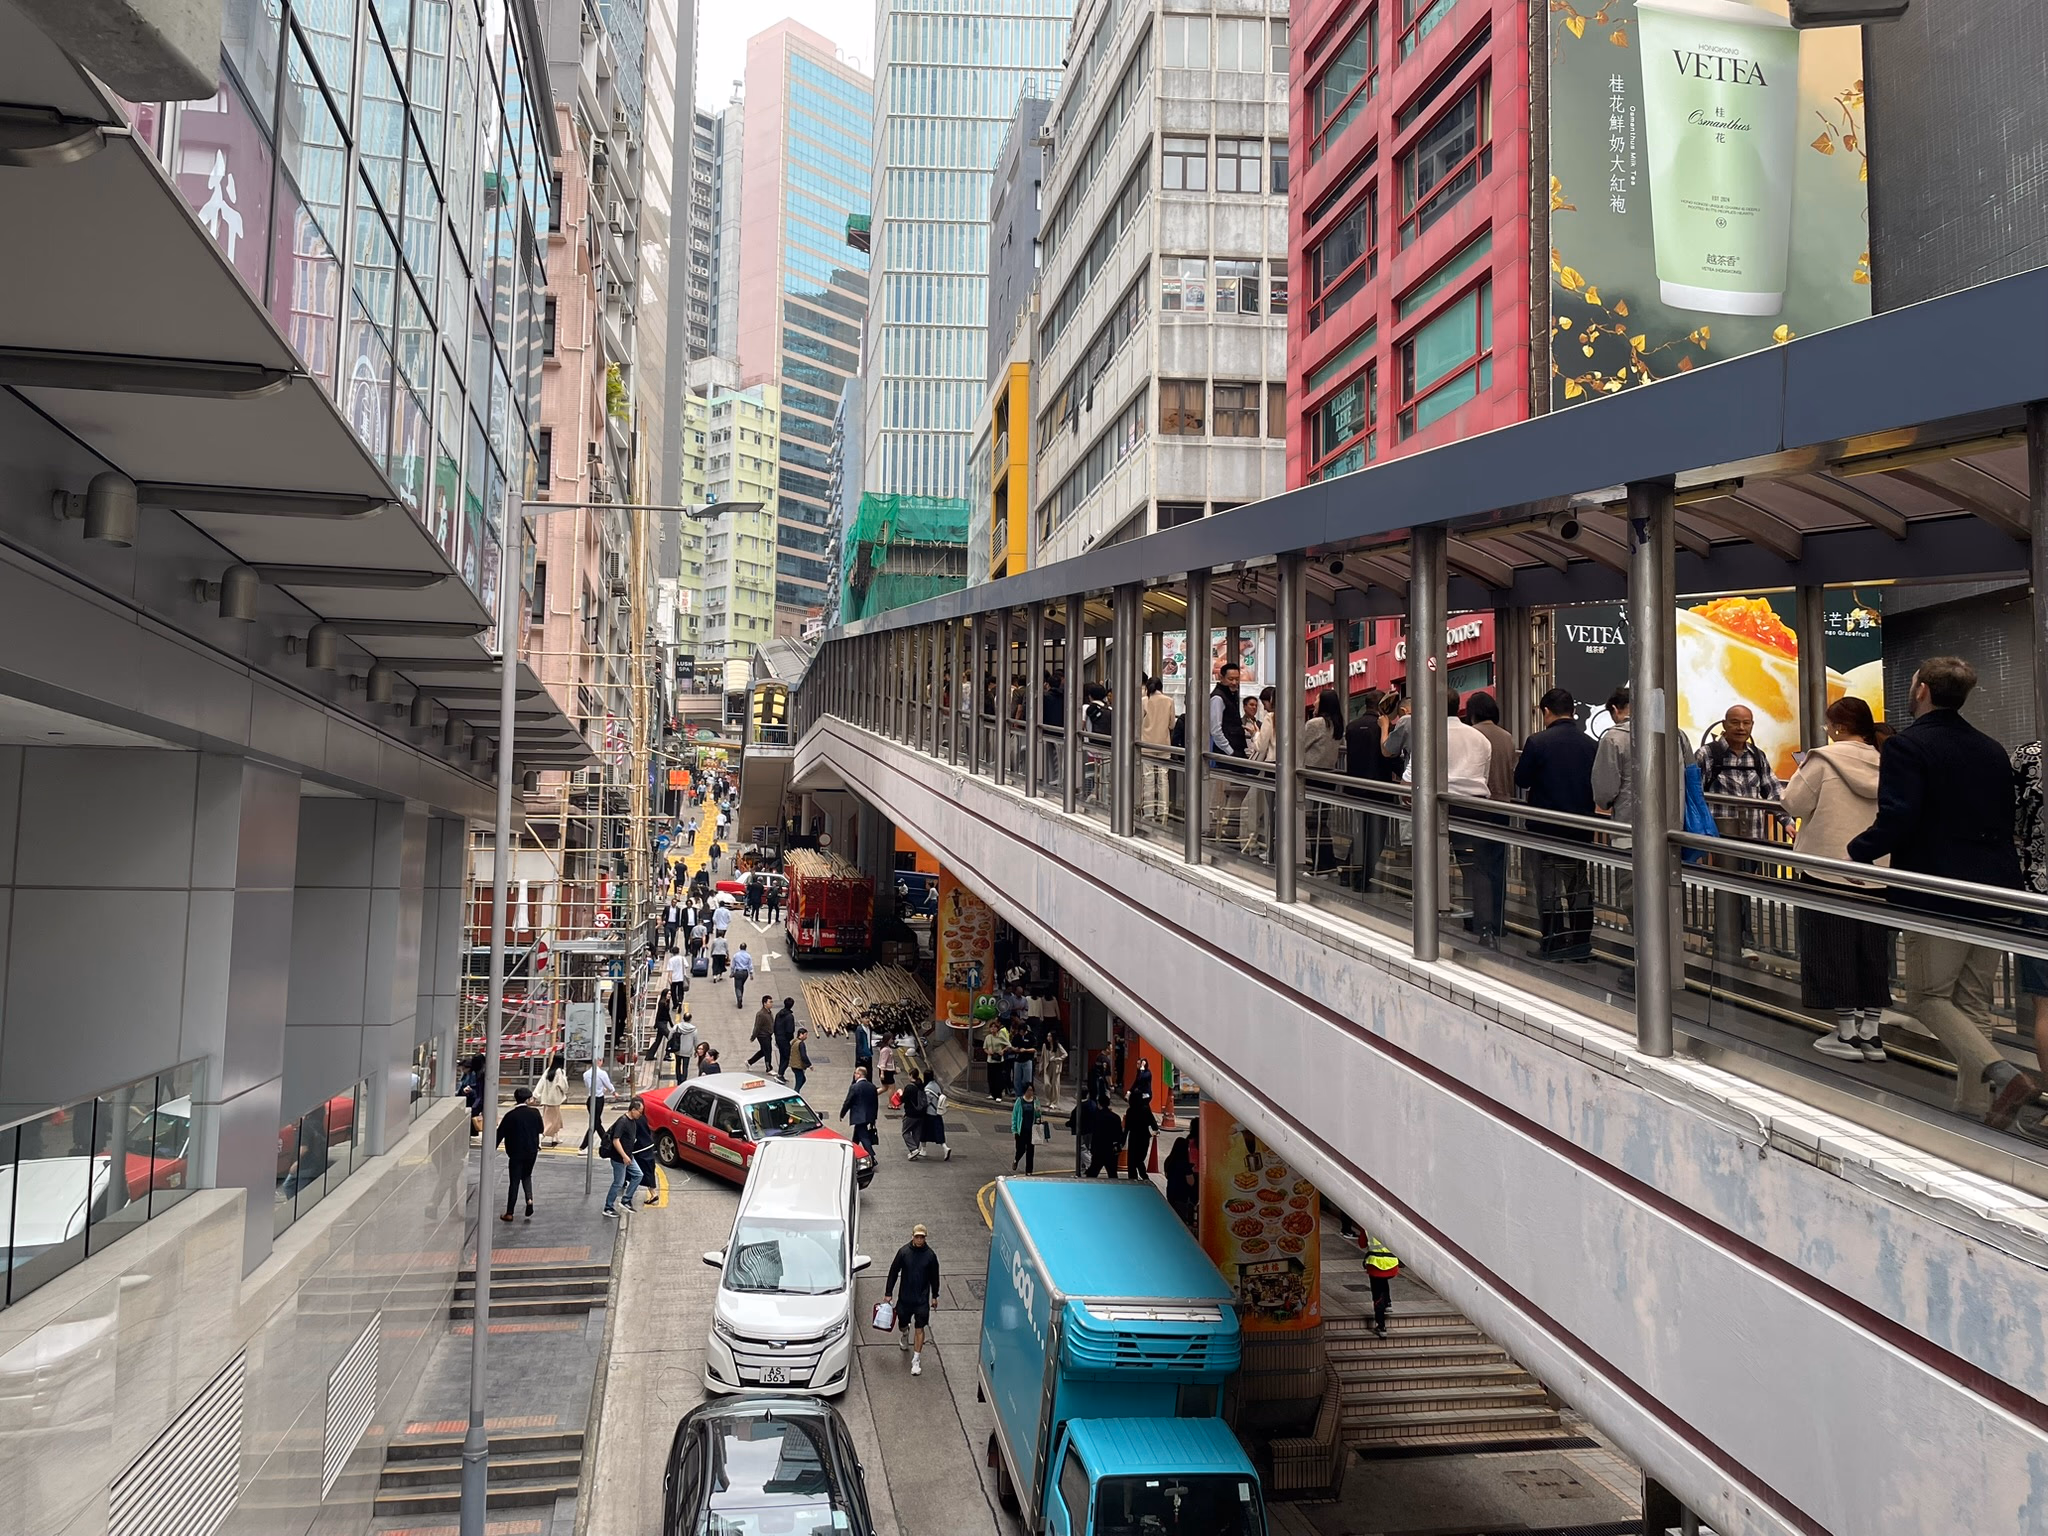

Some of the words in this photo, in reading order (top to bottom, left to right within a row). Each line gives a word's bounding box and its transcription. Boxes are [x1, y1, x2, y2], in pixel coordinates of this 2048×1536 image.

[1698, 43, 1740, 56] HONGKONG
[1672, 49, 1769, 87] VETEA
[1688, 108, 1752, 132] Osmanthus
[1715, 106, 1726, 118] 桂
[1629, 105, 1637, 150] Osmanthus
[1608, 73, 1627, 214] 桂花鮮奶大紅袍
[1715, 132, 1726, 144] 花
[1823, 611, 1871, 629] 芒甘露
[1446, 619, 1483, 646] orner
[1564, 624, 1626, 645] VETEA
[1837, 629, 1870, 638] Grapefruit
[1349, 658, 1368, 678] ner
[763, 1374, 786, 1383] 1363
[769, 1367, 782, 1376] AS
